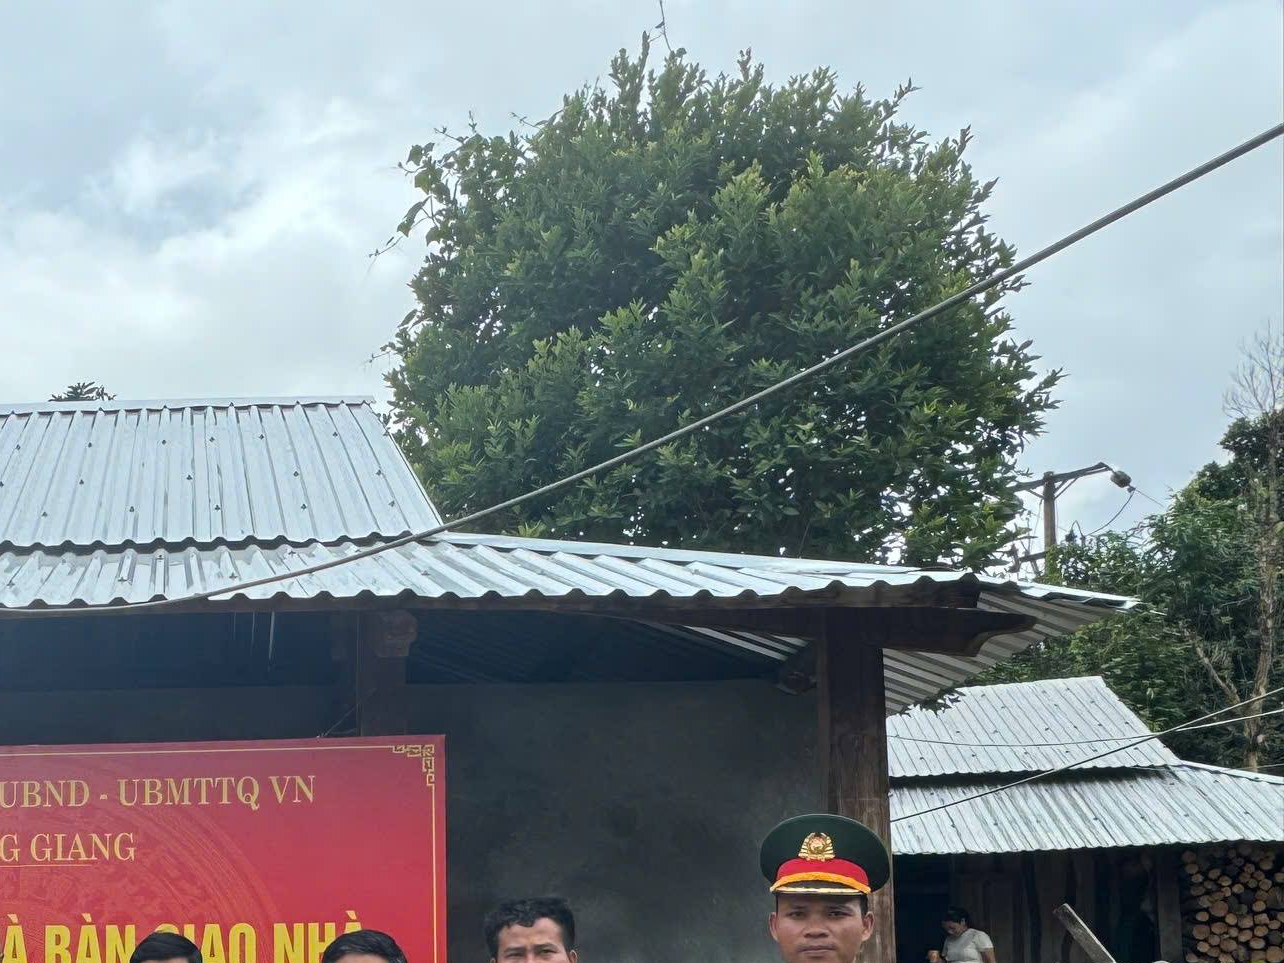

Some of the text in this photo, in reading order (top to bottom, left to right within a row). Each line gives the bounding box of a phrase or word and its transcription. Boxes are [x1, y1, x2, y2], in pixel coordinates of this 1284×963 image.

[117, 776, 260, 811] UBMTTQ
[268, 775, 316, 804] VN
[30, 832, 136, 862] GIANG
